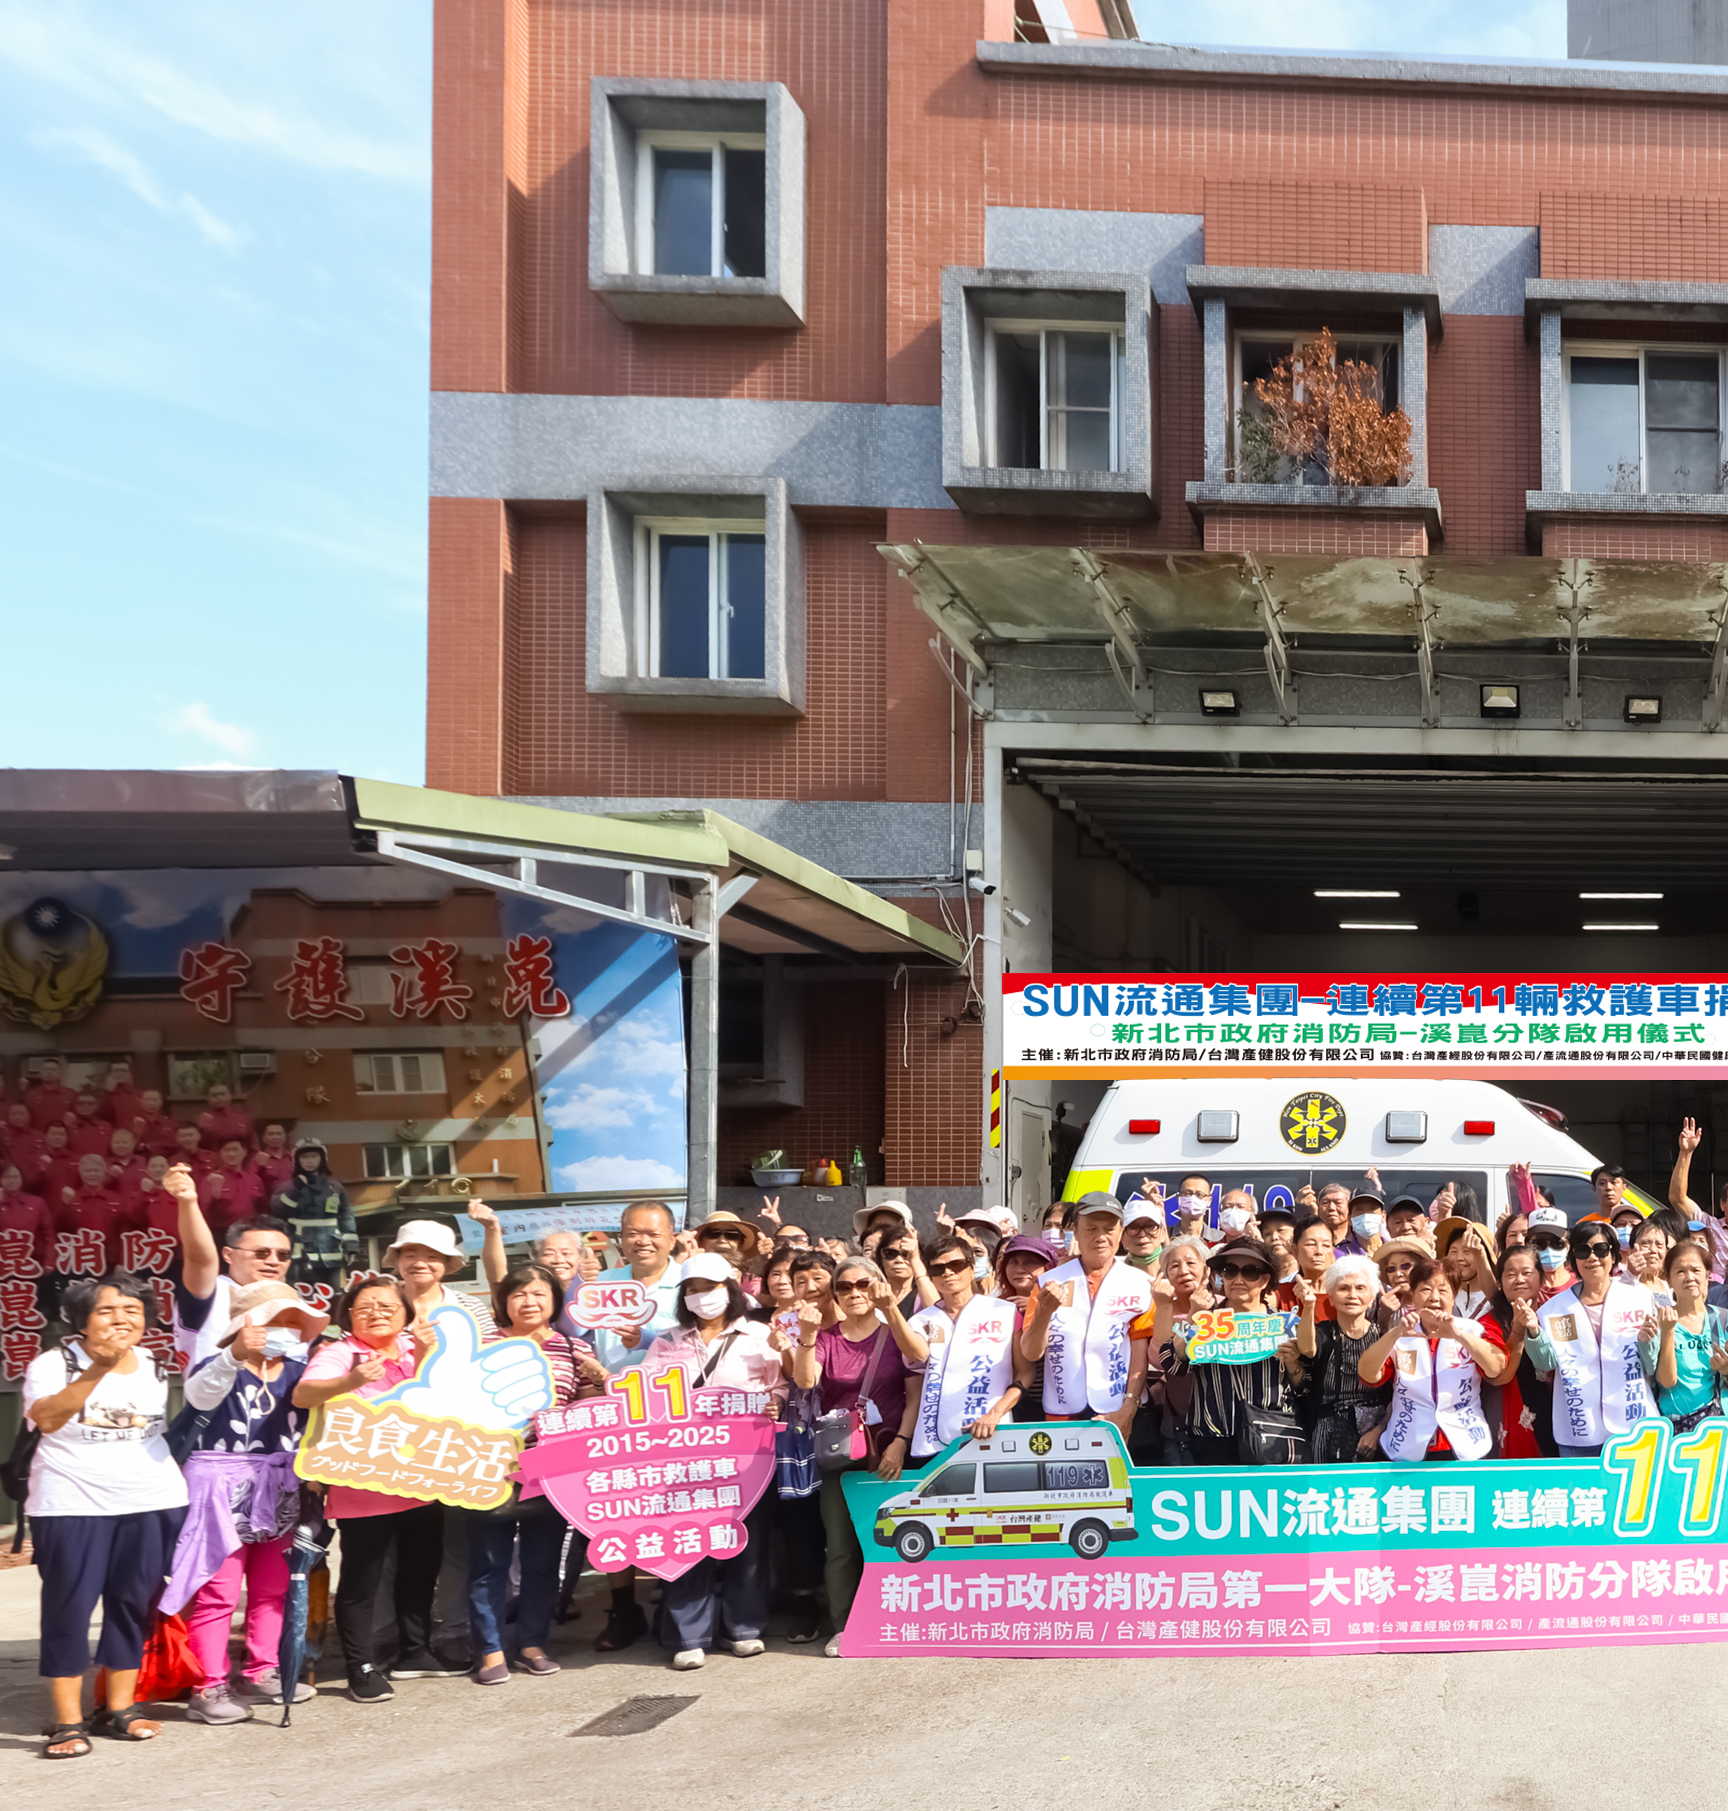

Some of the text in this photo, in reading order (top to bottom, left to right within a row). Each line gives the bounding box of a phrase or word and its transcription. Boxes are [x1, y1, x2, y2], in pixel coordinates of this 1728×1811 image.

[179, 933, 571, 1023] 守護溪崑
[1111, 1021, 1706, 1044] 新北市政府消防局-溪崑分隊啟用儀式
[584, 1289, 639, 1309] SKR
[1106, 1295, 1141, 1308] SKR
[967, 1320, 1003, 1336] SKR
[1612, 1309, 1645, 1325] SKR
[1558, 1347, 1588, 1438] 人々の幸せのために
[316, 1406, 513, 1484] 良食生活
[587, 1425, 731, 1458] 2015~2025
[586, 1457, 738, 1494] 各縣市救護車
[1046, 1464, 1079, 1488] 119
[587, 1485, 742, 1521] SUN流通集團
[1151, 1486, 1476, 1541] SUN流通集團
[596, 1523, 738, 1564] 公益活動
